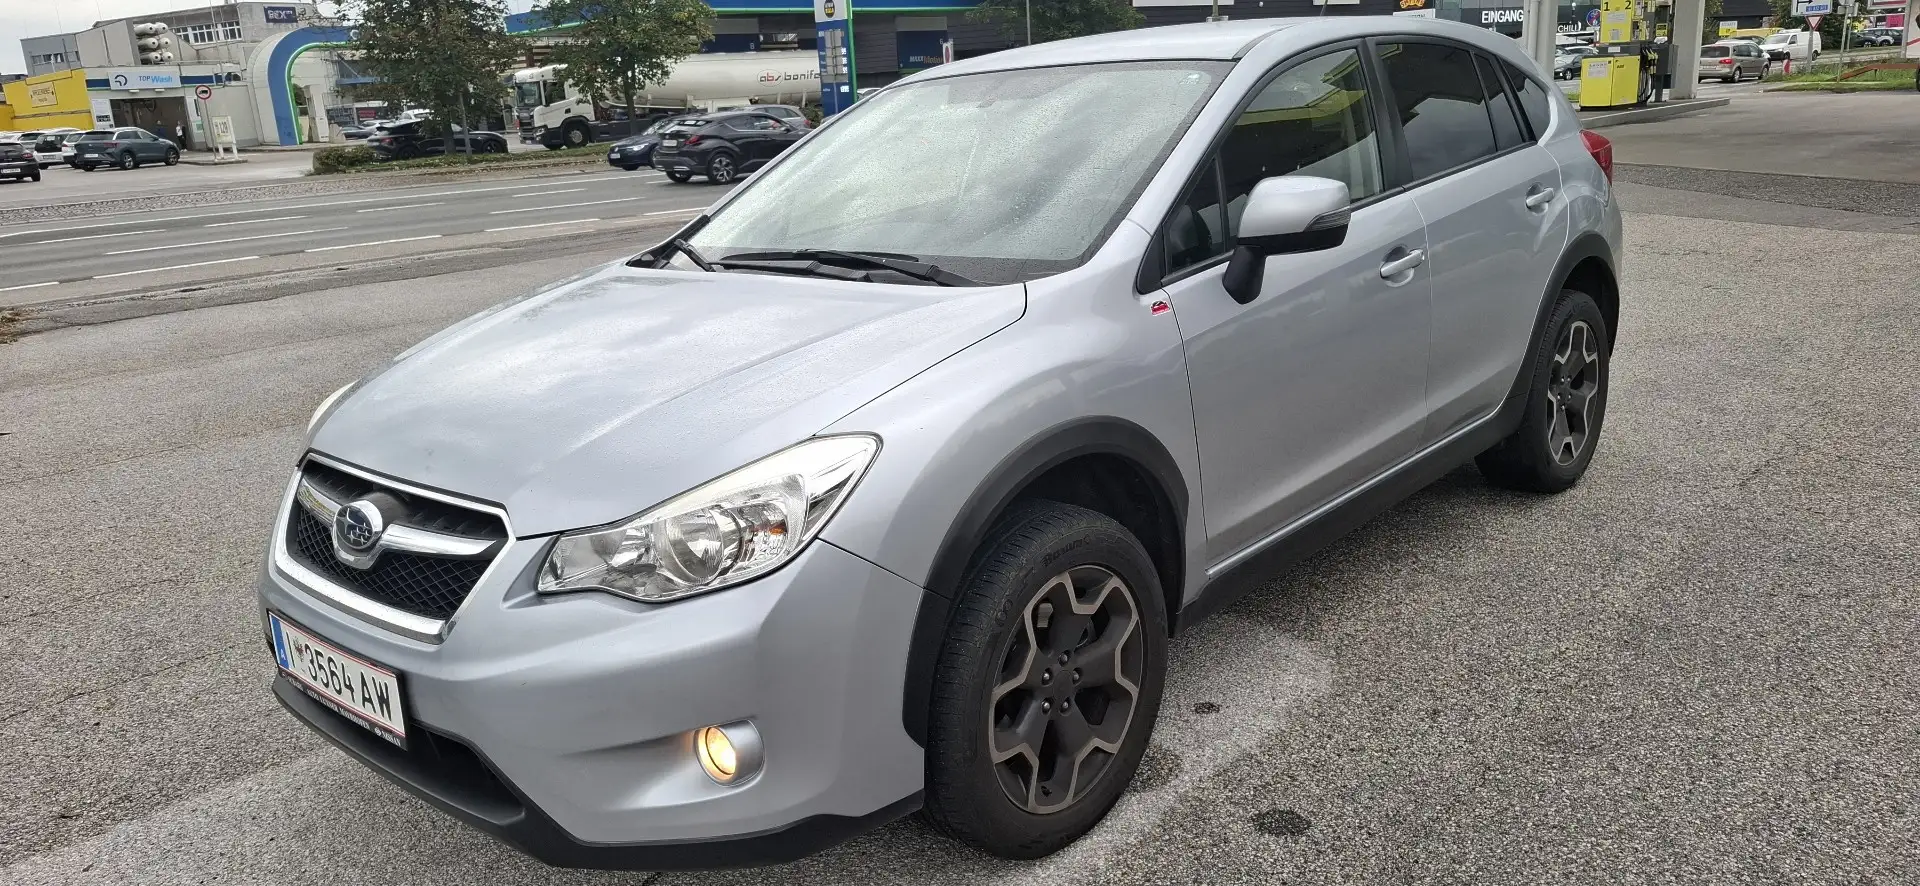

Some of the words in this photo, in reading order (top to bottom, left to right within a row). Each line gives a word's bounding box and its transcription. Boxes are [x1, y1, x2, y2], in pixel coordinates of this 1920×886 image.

[1603, 2, 1610, 12] 1
[1624, 0, 1632, 10] 2
[1481, 9, 1524, 24] EINGANG
[759, 72, 781, 82] abs
[304, 642, 356, 704] 3564
[360, 670, 392, 722] AW
